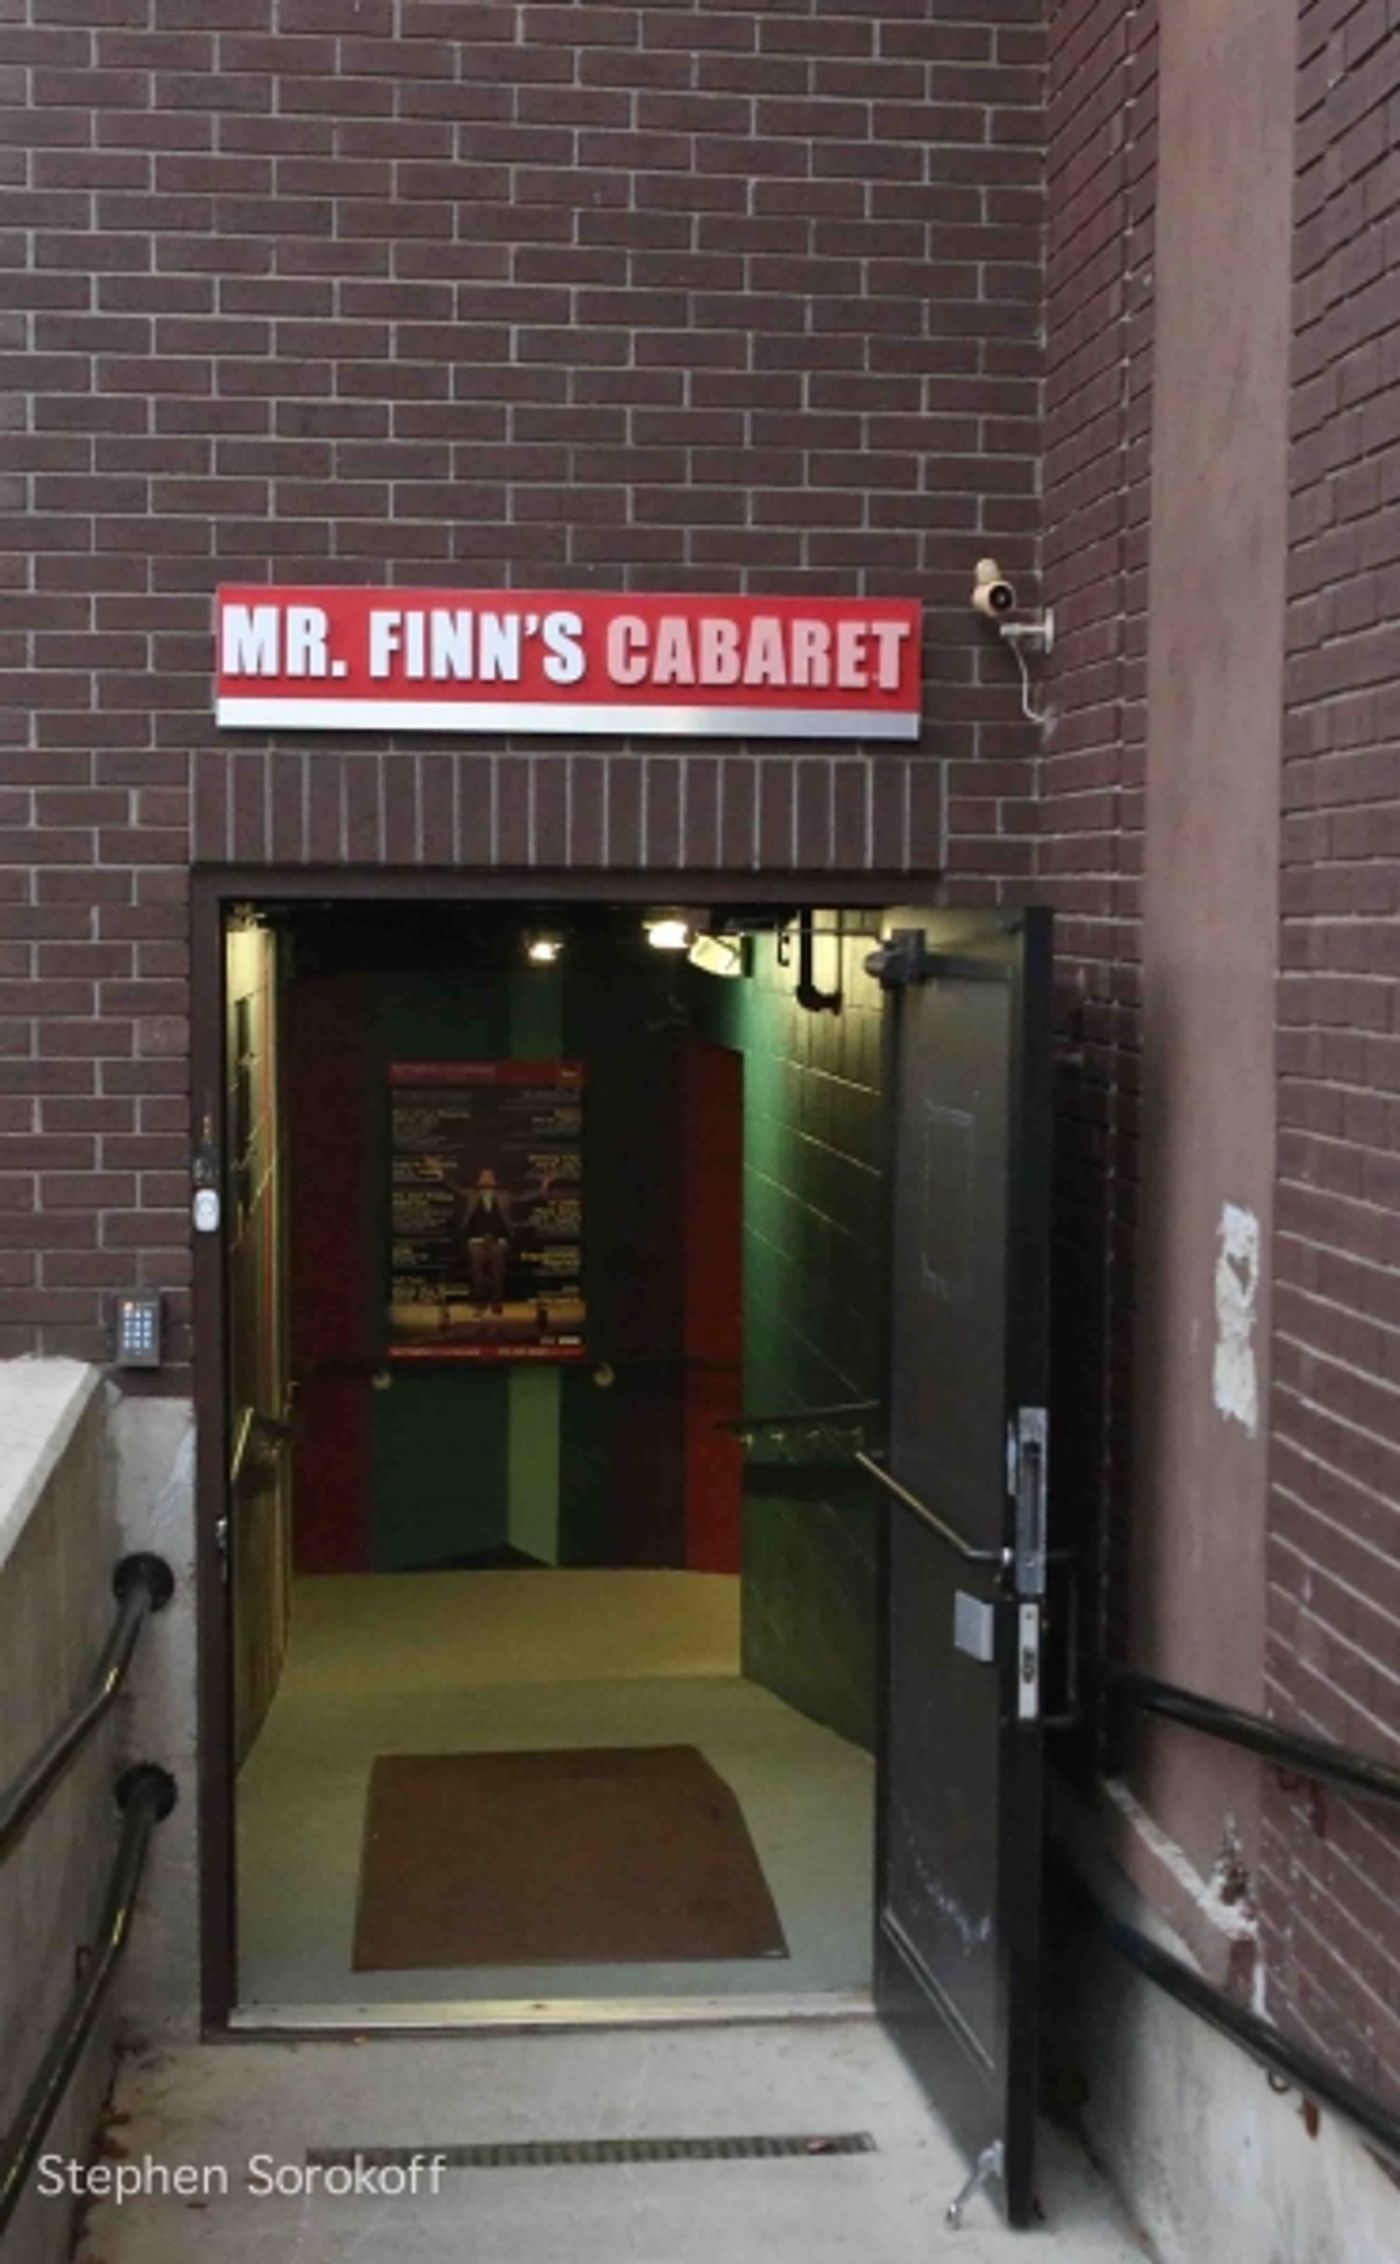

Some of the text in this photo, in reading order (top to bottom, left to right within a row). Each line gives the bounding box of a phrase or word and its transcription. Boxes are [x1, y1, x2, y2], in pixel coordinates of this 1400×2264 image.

[222, 605, 911, 689] MR. FINN'S CABARET
